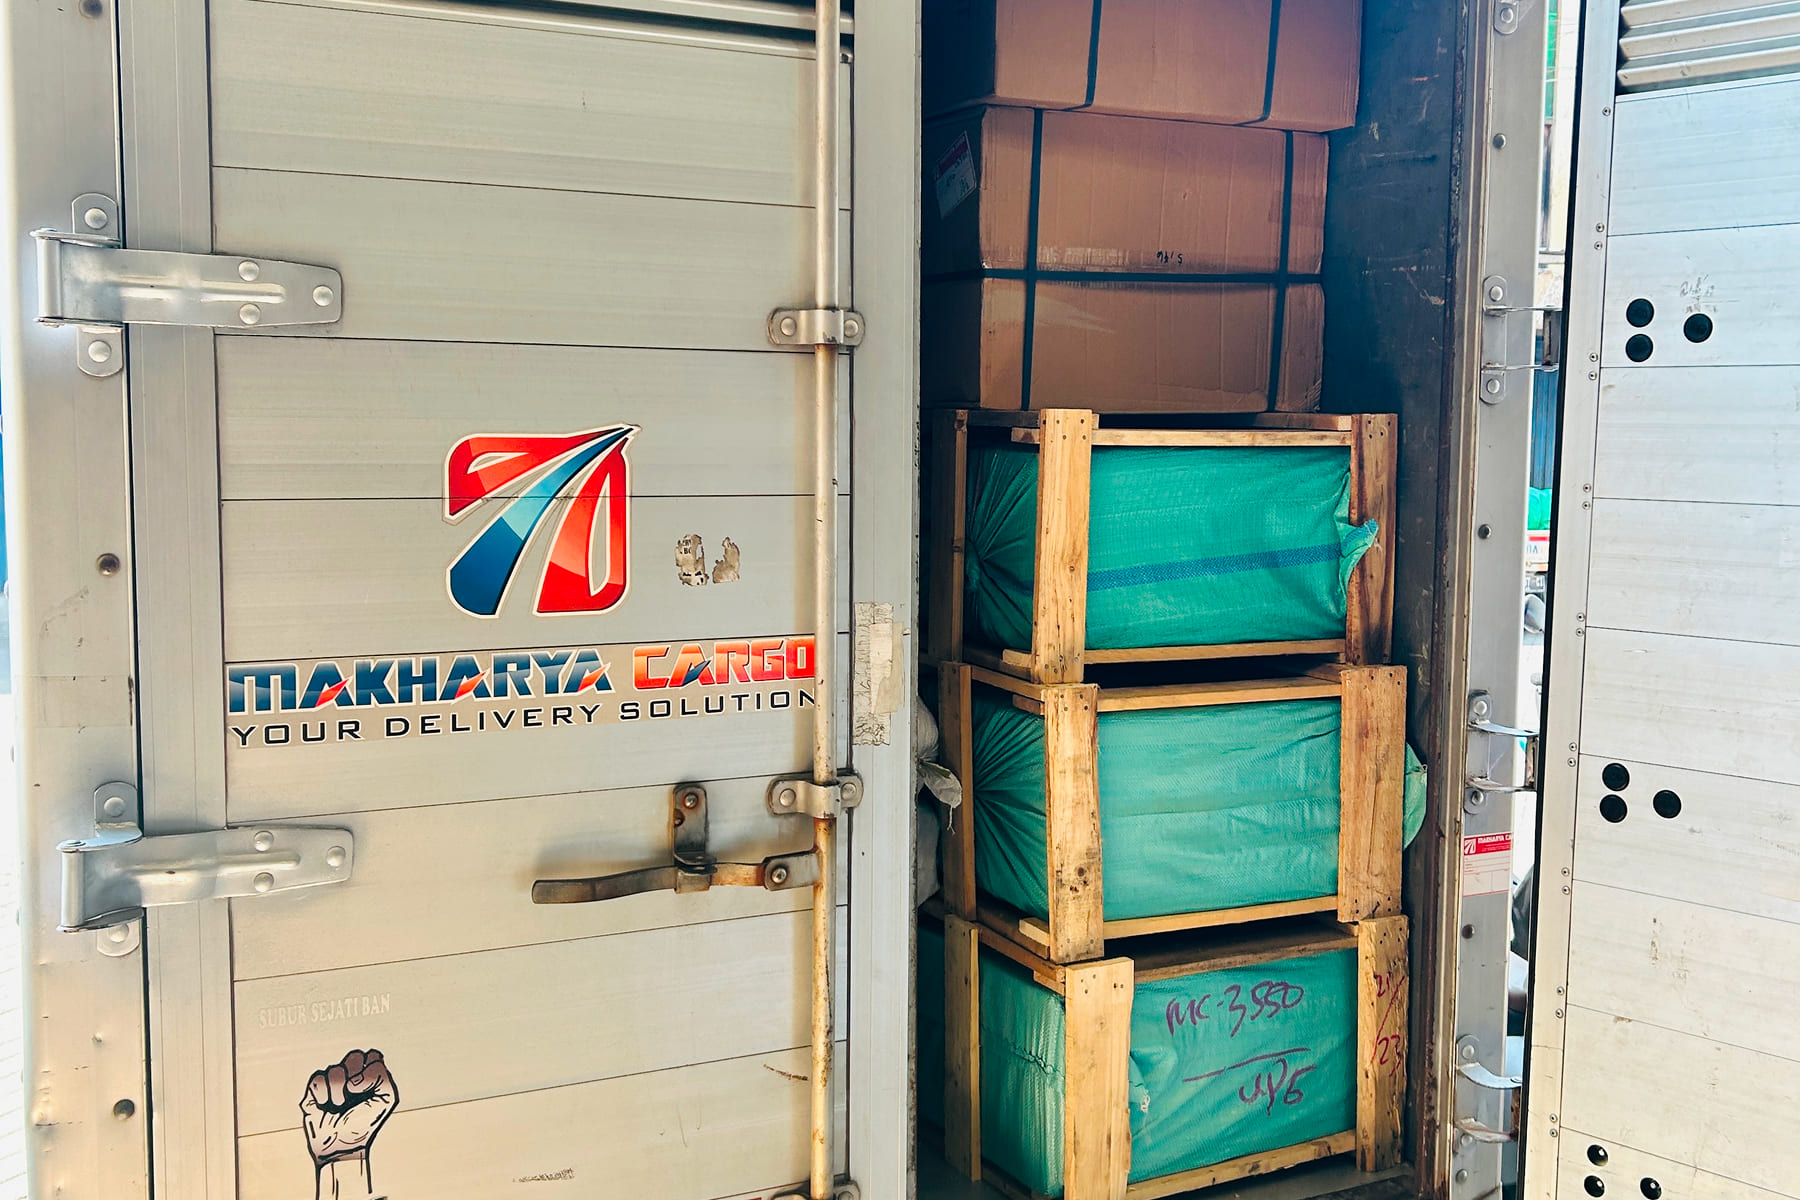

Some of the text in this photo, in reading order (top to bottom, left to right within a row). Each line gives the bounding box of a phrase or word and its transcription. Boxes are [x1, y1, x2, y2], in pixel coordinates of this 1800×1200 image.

[228, 637, 815, 713] MAKHARYA CARGO
[232, 720, 361, 746] YOUR
[385, 704, 601, 738] DELIVERY
[259, 993, 391, 1029] SUBUR SEJATI BAN
